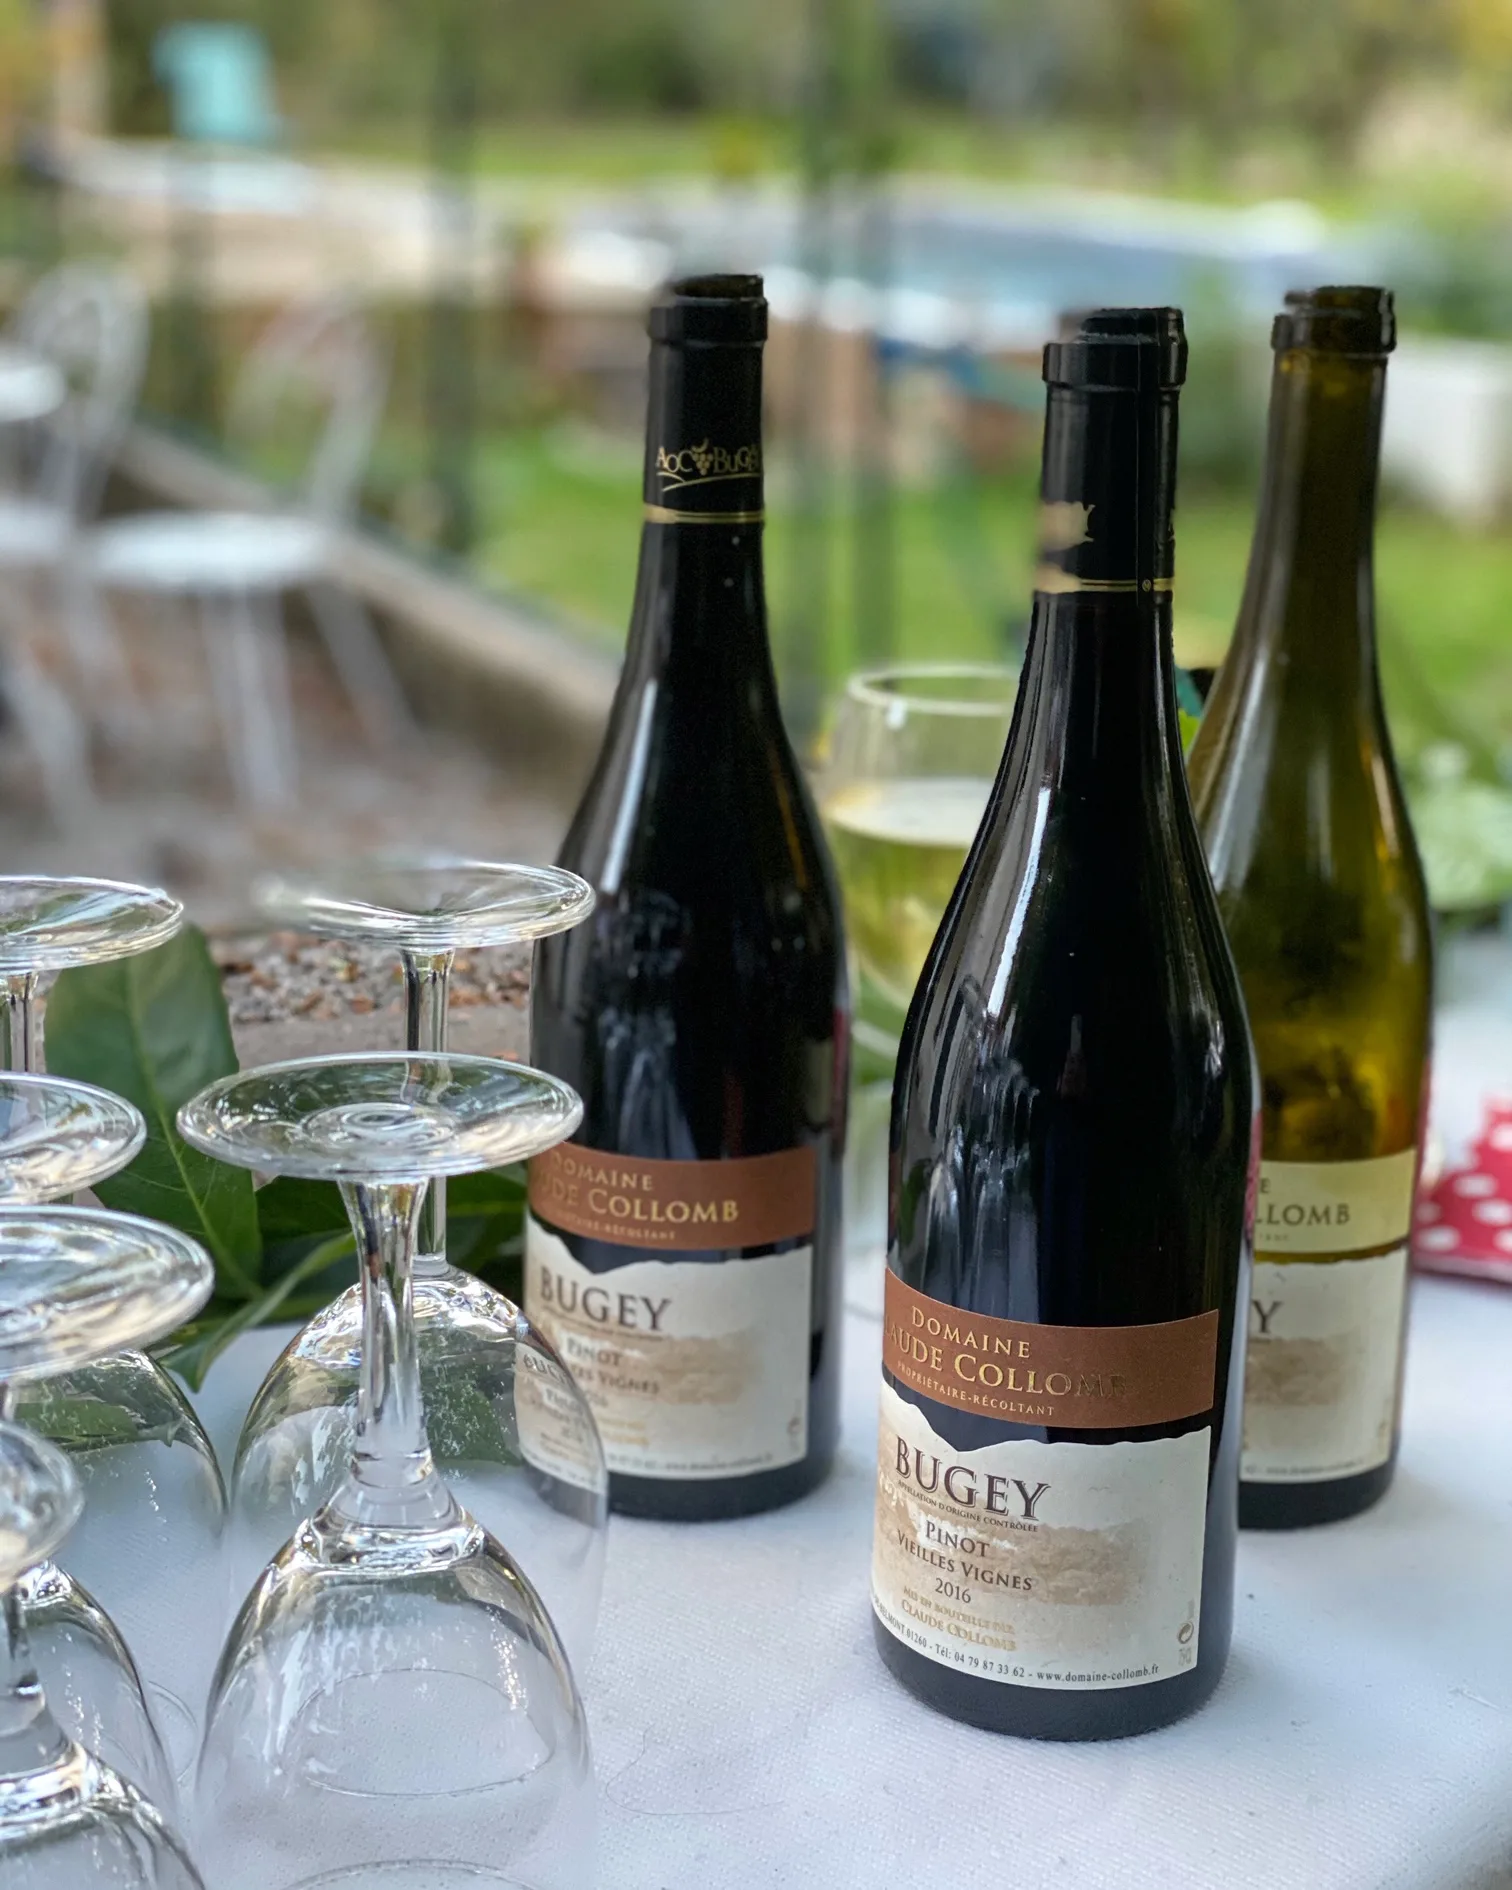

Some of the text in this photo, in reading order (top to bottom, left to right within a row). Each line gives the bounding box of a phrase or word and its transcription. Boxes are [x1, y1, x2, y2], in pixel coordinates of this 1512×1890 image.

[550, 1151, 654, 1191] DOMAINE
[587, 1188, 739, 1224] COLLOMB
[541, 1265, 673, 1331] BUGEY
[911, 1305, 1031, 1359] DOMAINE
[897, 1360, 1055, 1417] PROPRIÉTAIRE-RÉCOLTANT
[896, 1435, 1052, 1522] BUGEY
[897, 1480, 938, 1507] APPELLATION
[938, 1503, 982, 1523] D'ORIGINE
[897, 1528, 1033, 1592] VIEILLES VIGNES
[926, 1519, 991, 1558] PINOT
[934, 1577, 972, 1604] 2016
[901, 1599, 944, 1632] CLAUDE
[906, 1627, 928, 1649] 01260
[954, 1650, 965, 1664] 04
[968, 1655, 979, 1668] 79
[982, 1661, 994, 1672] 87
[997, 1663, 1009, 1675] 33
[1012, 1666, 1025, 1678] 62
[1036, 1663, 1160, 1682] www.domaine-collomb.fr
